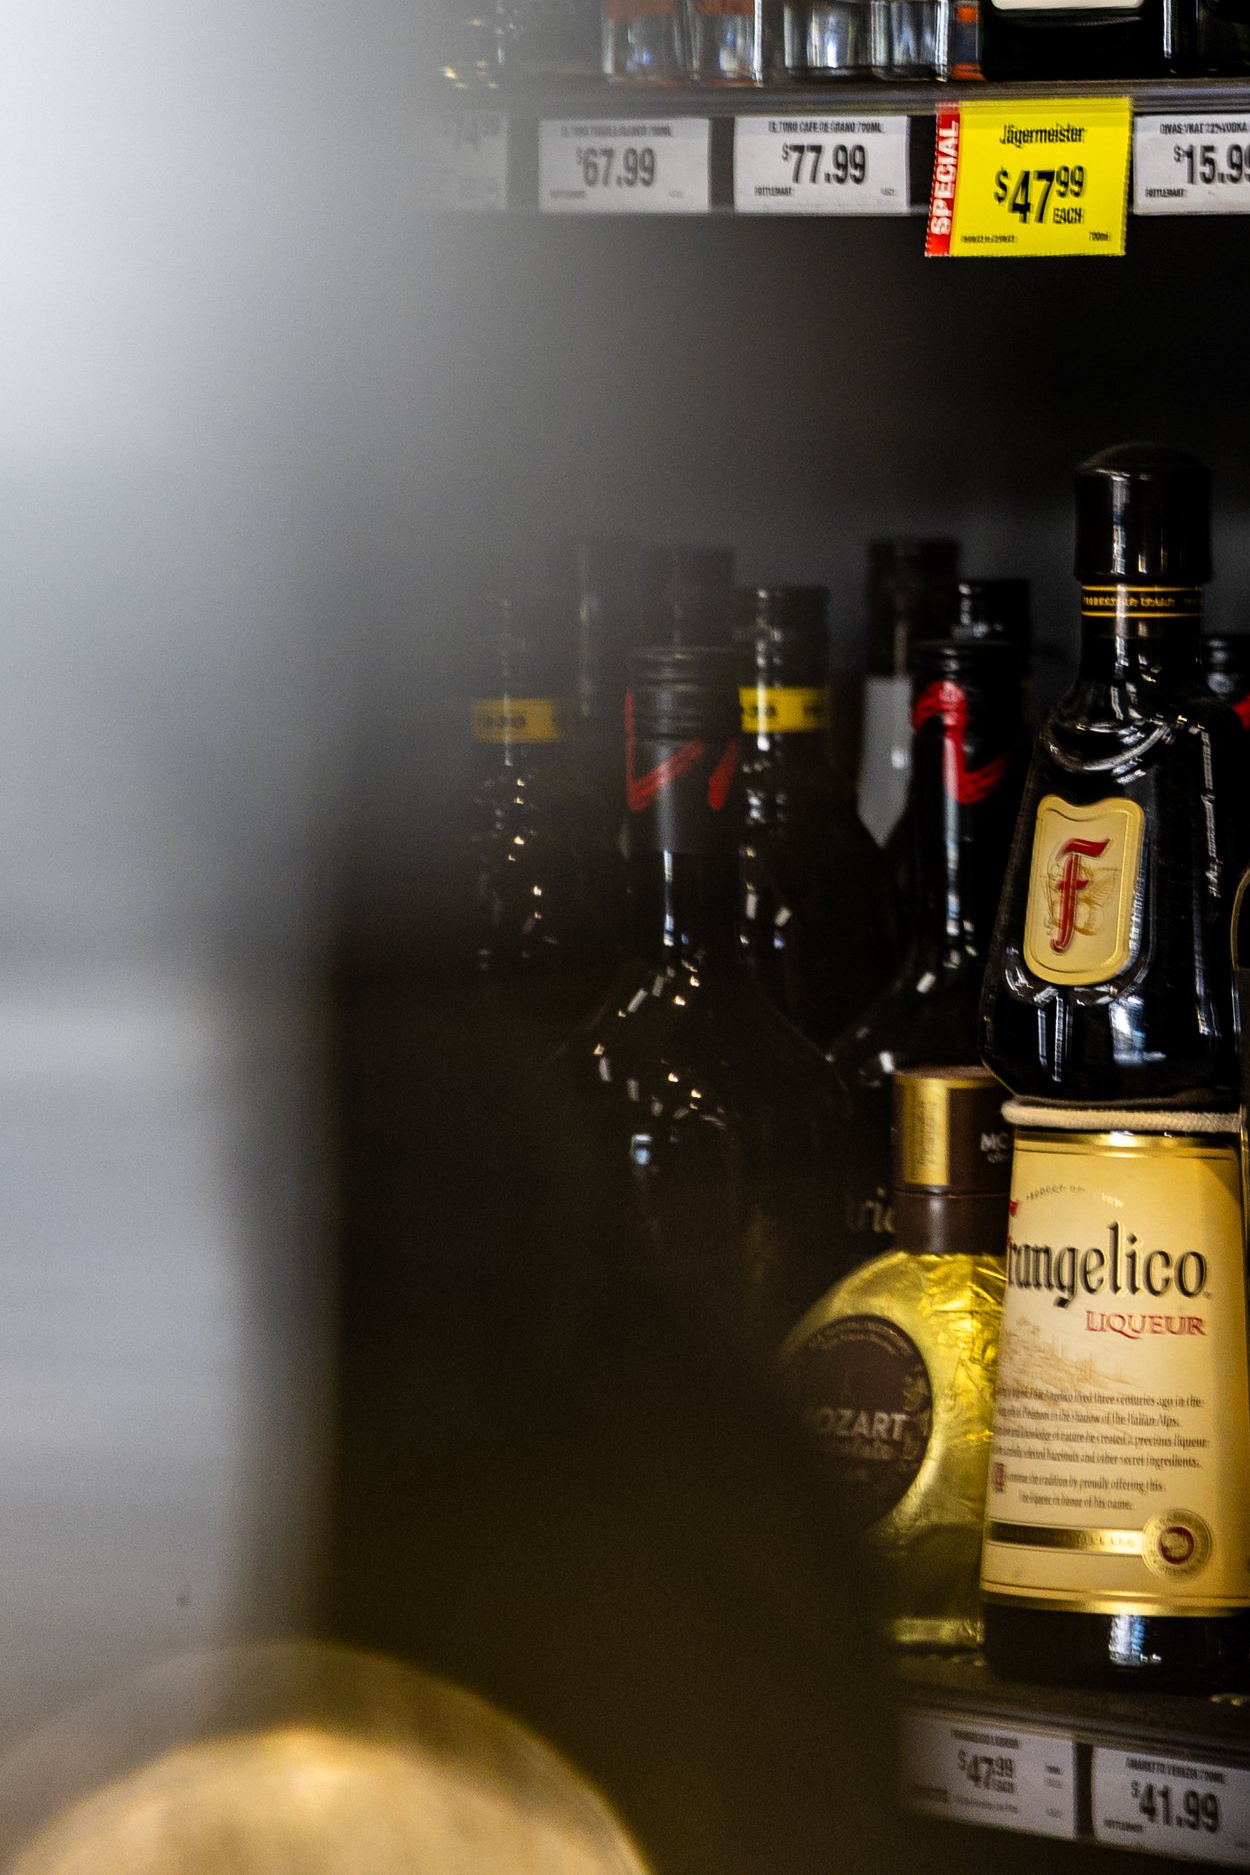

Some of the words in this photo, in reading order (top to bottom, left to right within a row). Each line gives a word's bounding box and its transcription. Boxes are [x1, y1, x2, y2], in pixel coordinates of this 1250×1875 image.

[778, 121, 798, 134] TORO
[999, 123, 1086, 149] Jägermeister
[1159, 123, 1182, 135] DIVAS
[1184, 123, 1204, 134] VKAT
[1222, 121, 1247, 133] VODKA
[576, 147, 657, 188] $67.99
[782, 143, 867, 185] $77.99
[930, 120, 960, 236] SPECIAL
[1053, 207, 1084, 225] EACH
[1050, 838, 1111, 953] F
[1084, 1309, 1208, 1341] LIQUEUR
[1094, 1391, 1115, 1406] three
[1115, 1393, 1155, 1406] centuries
[1156, 1396, 1174, 1408] ago
[1175, 1397, 1185, 1407] in
[1186, 1394, 1204, 1408] the
[1101, 1411, 1111, 1424] of
[1112, 1411, 1126, 1424] the
[1174, 1433, 1208, 1450] liqueur
[1096, 1451, 1118, 1466] other
[1119, 1453, 1146, 1467] secret
[1147, 1478, 1164, 1492] this
[1130, 1779, 1219, 1834] $41.99
